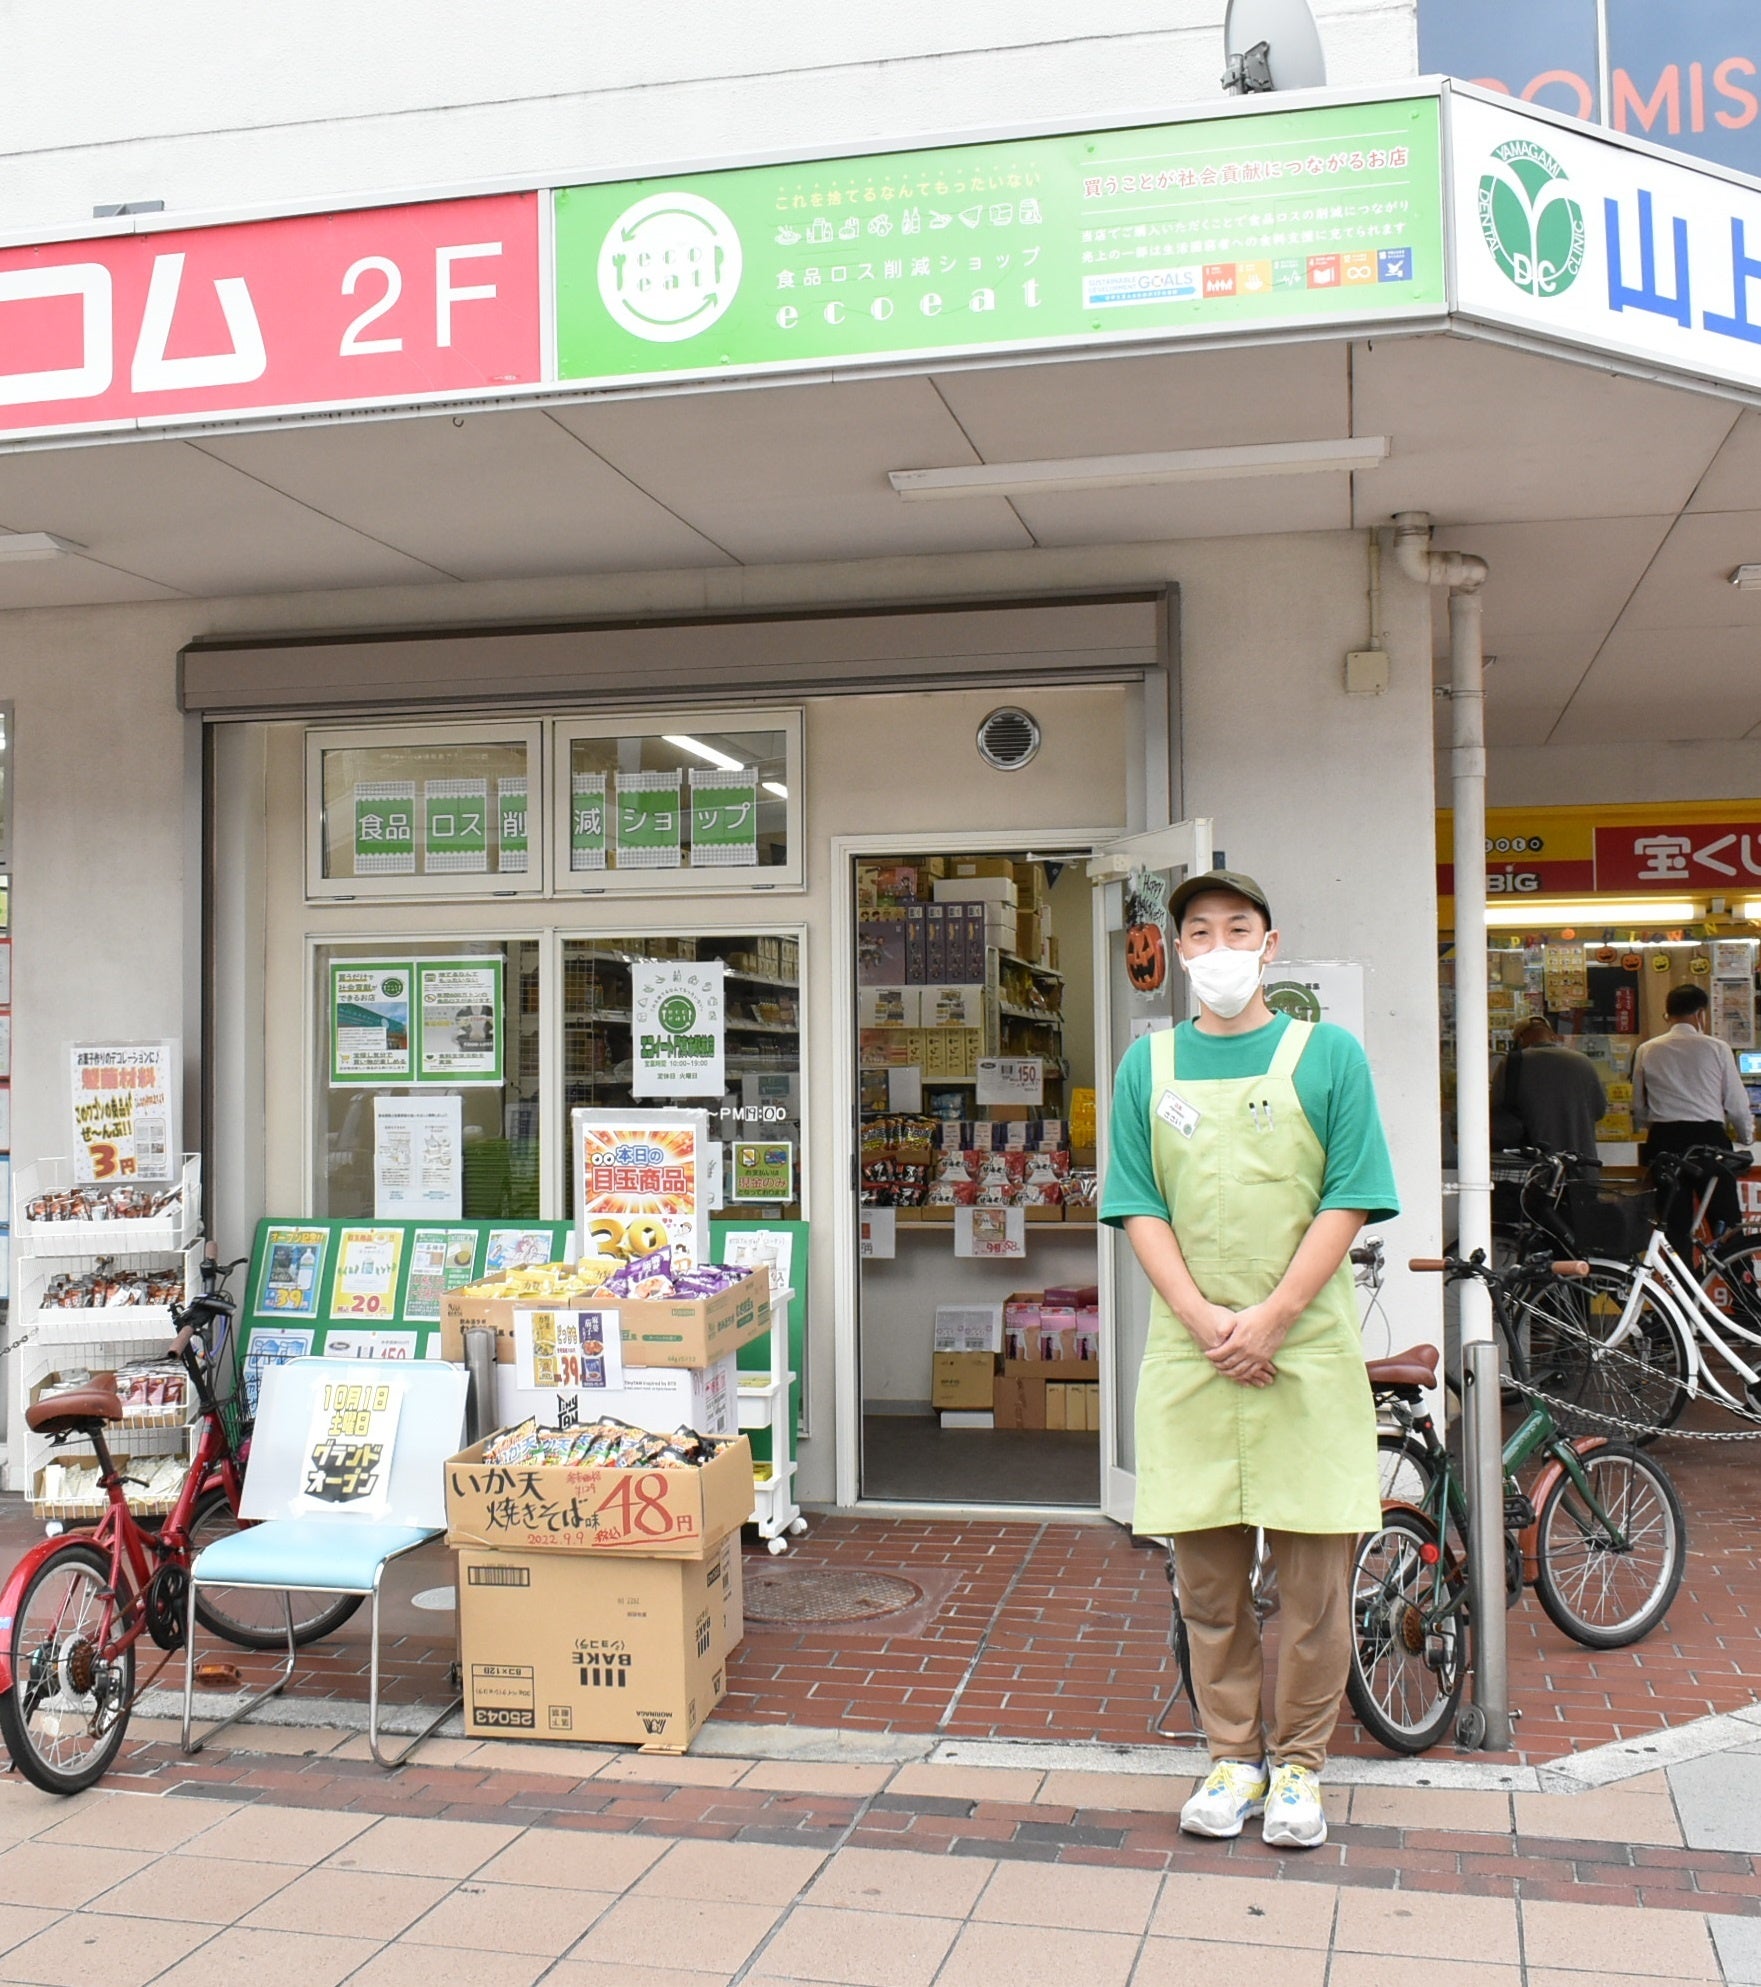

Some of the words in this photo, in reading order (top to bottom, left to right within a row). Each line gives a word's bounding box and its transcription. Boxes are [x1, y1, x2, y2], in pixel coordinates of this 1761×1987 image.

[1464, 57, 1759, 135] OMIS
[1083, 147, 1409, 197] 買うことが社会貢献につながるお店
[1496, 142, 1561, 178] YAMAGAMI
[775, 172, 1041, 211] これを捨てるなんてもったいない
[1478, 188, 1502, 258] DENTAL
[1567, 219, 1584, 276] CLINIC
[775, 246, 1041, 290] 食品ロス削減ショップ
[1603, 187, 1761, 345] 山上
[1137, 271, 1193, 290] GOALS
[0, 252, 267, 405] コム
[338, 993, 376, 1002] できるお店
[656, 1072, 676, 1080] 定休日
[679, 1072, 698, 1080] 火曜日
[615, 1145, 664, 1166] 本日の
[592, 1165, 687, 1194] 目玉商品
[737, 1176, 787, 1189] 現金のみ
[324, 1384, 389, 1411] 10月1日
[327, 1410, 371, 1437] 土曜日
[312, 1439, 383, 1467] グランド
[307, 1467, 379, 1495] オープン
[452, 1468, 545, 1501] いか天
[527, 1532, 584, 1545] 2022.9.9
[571, 1651, 632, 1667] BAKE
[475, 1709, 534, 1725] 25043
[636, 1710, 672, 1718] MORINAGA
